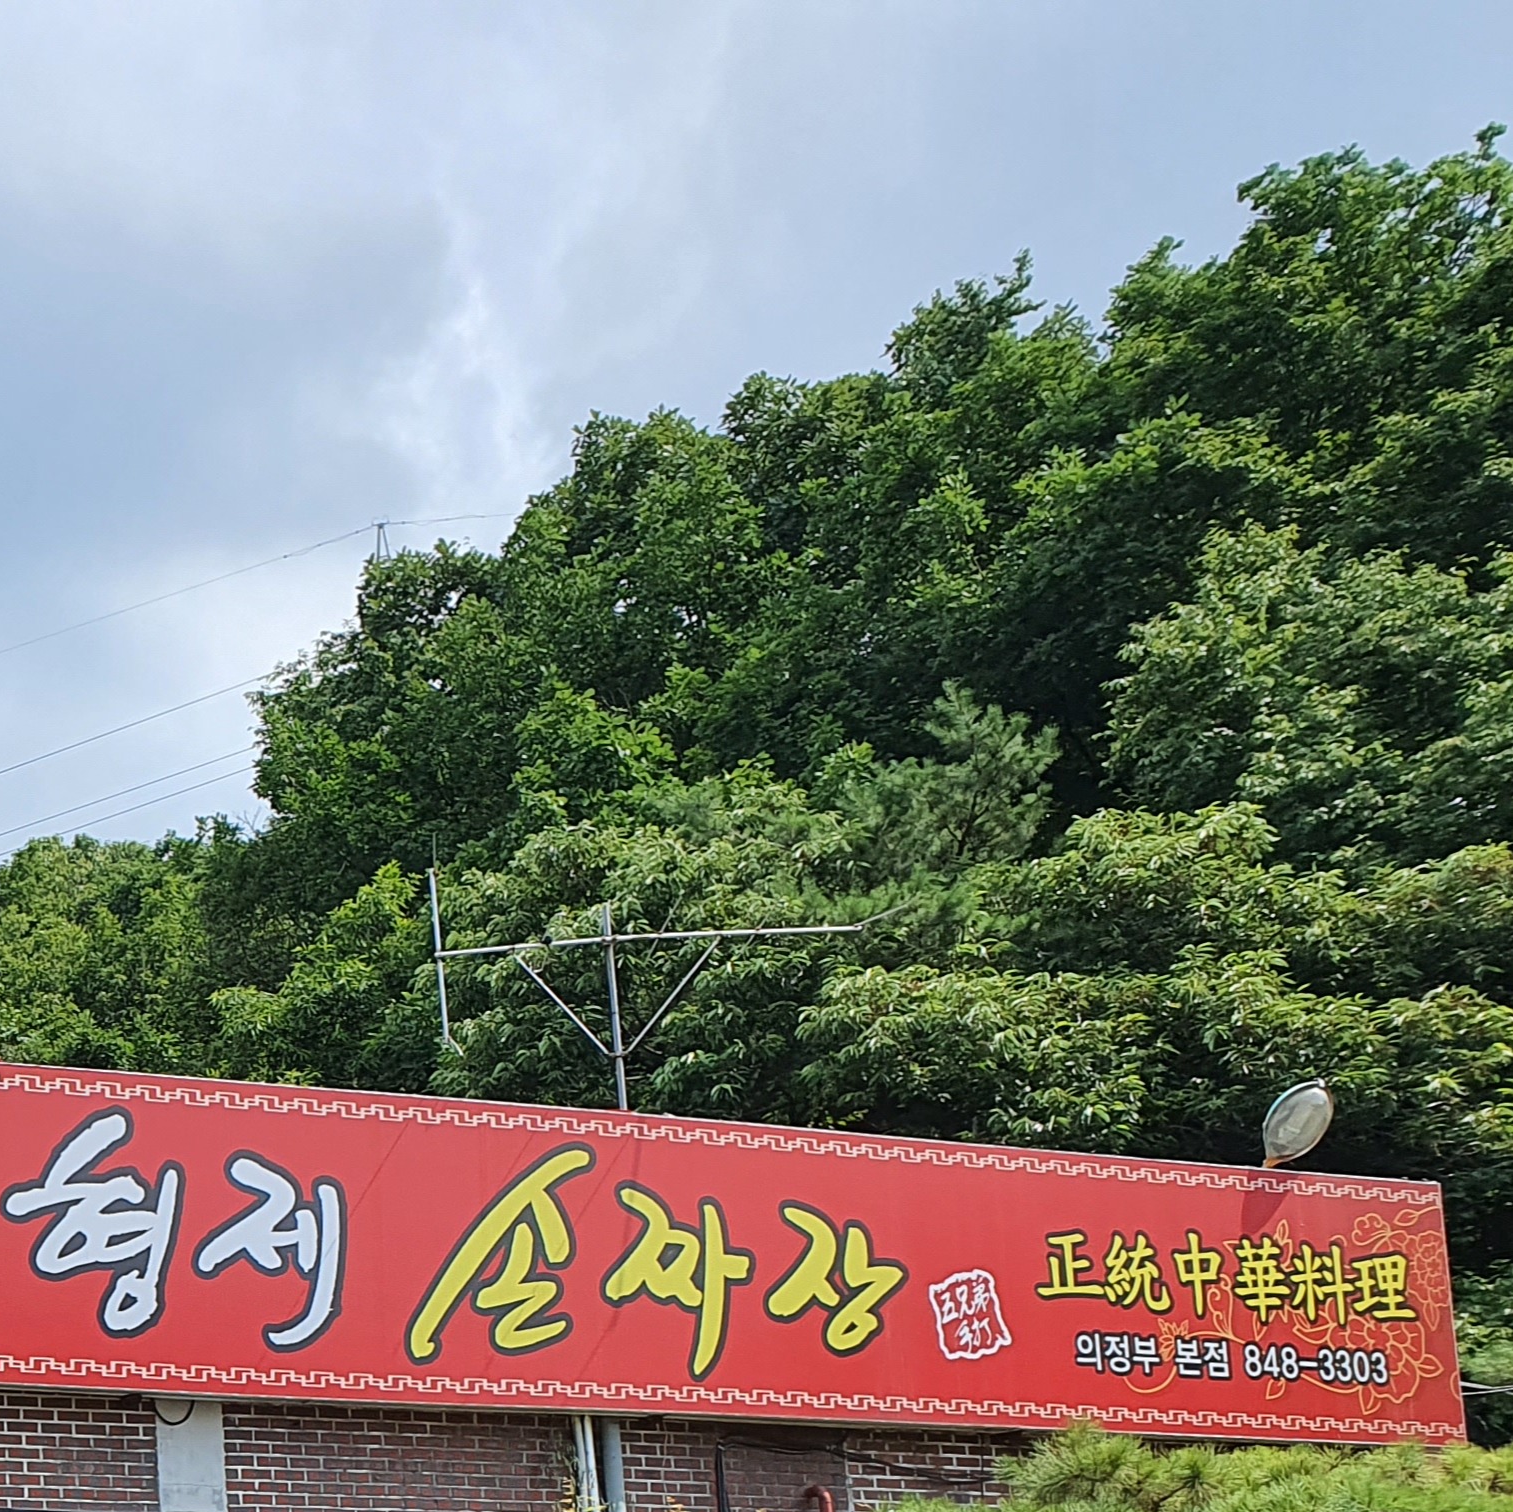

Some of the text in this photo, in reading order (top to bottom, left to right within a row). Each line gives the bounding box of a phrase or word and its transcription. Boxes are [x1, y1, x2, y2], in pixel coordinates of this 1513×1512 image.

[411, 1149, 904, 1376] 손짜장
[1037, 1232, 1417, 1324] 正統中華料理
[1076, 1333, 1388, 1384] 의정부 본점 848-3303
